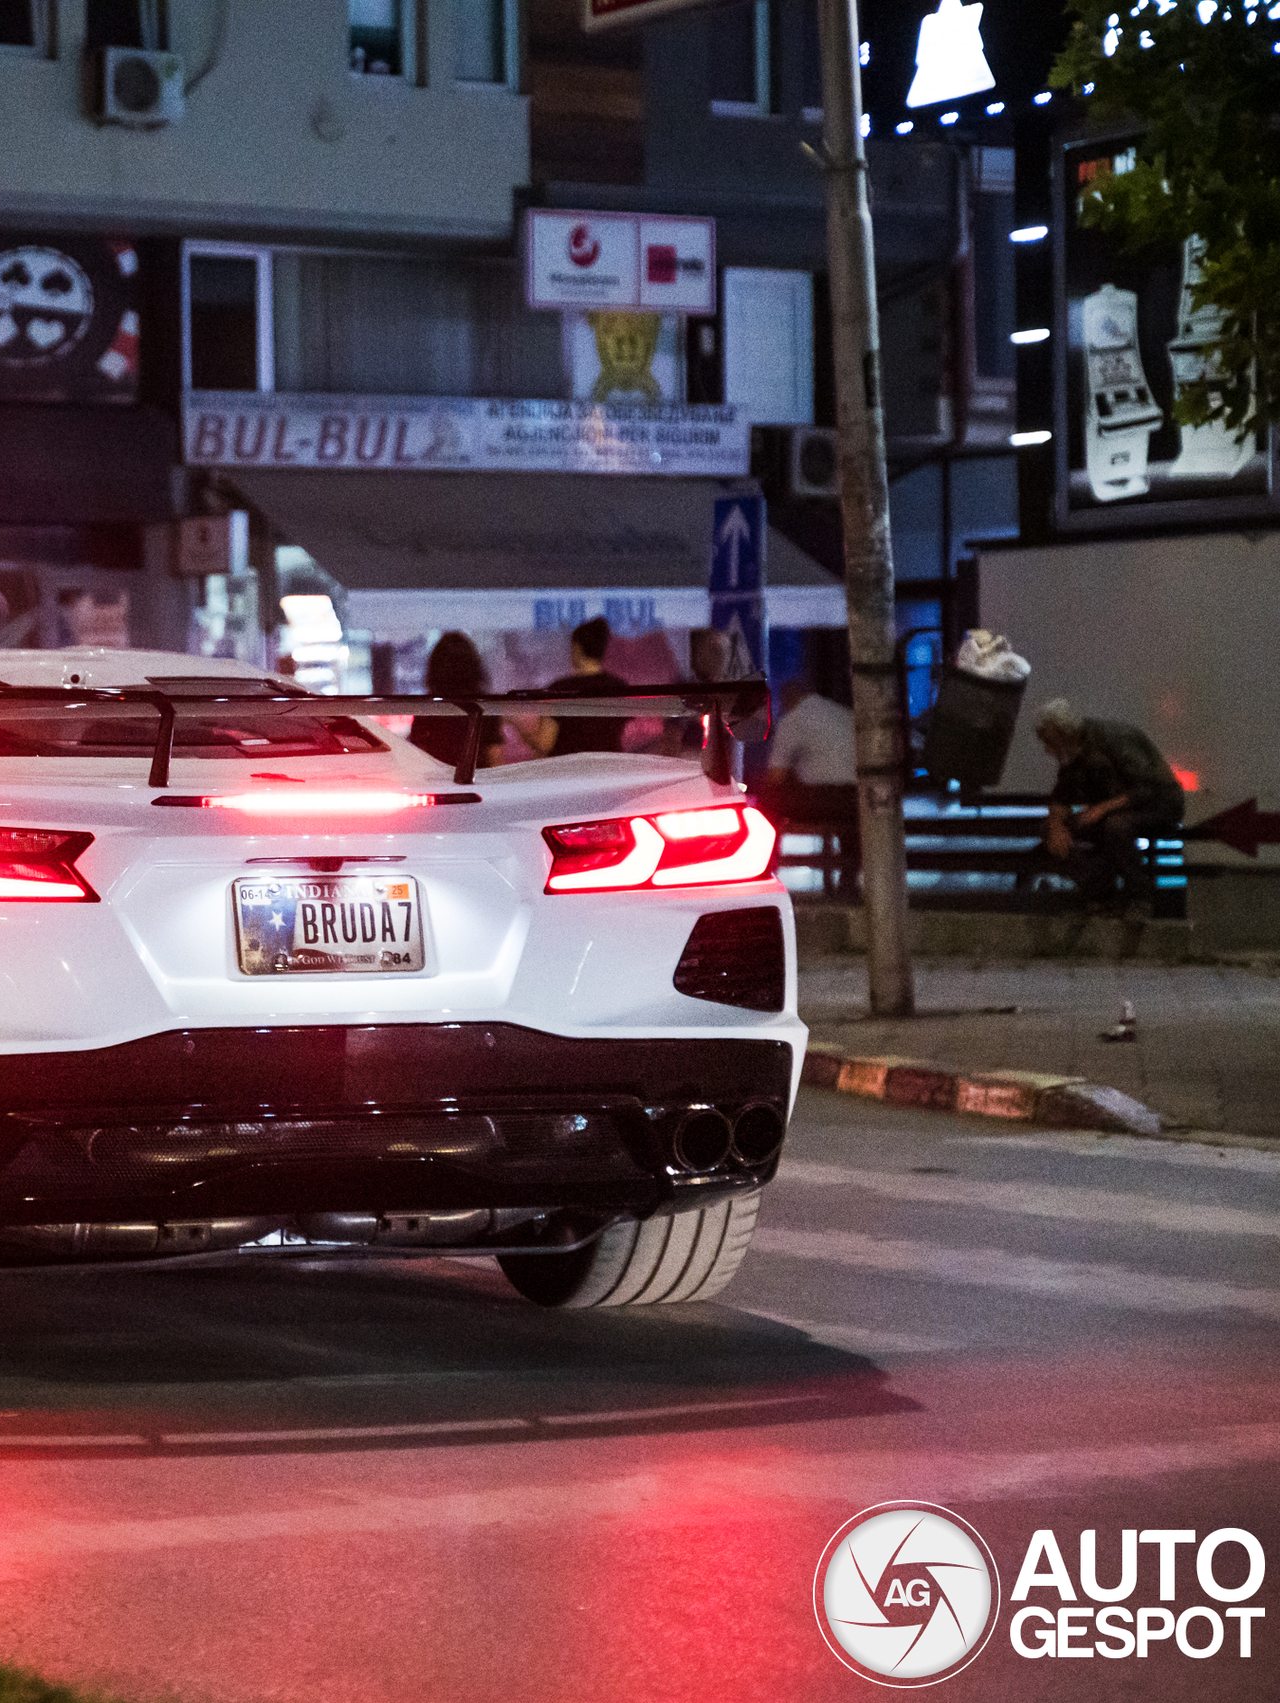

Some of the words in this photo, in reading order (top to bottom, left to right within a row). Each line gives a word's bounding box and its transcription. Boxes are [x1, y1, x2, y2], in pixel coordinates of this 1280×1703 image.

[192, 413, 417, 463] BUL-BUL
[285, 884, 369, 899] INDIANA
[391, 885, 403, 896] 25
[302, 901, 412, 944] BRUDA7
